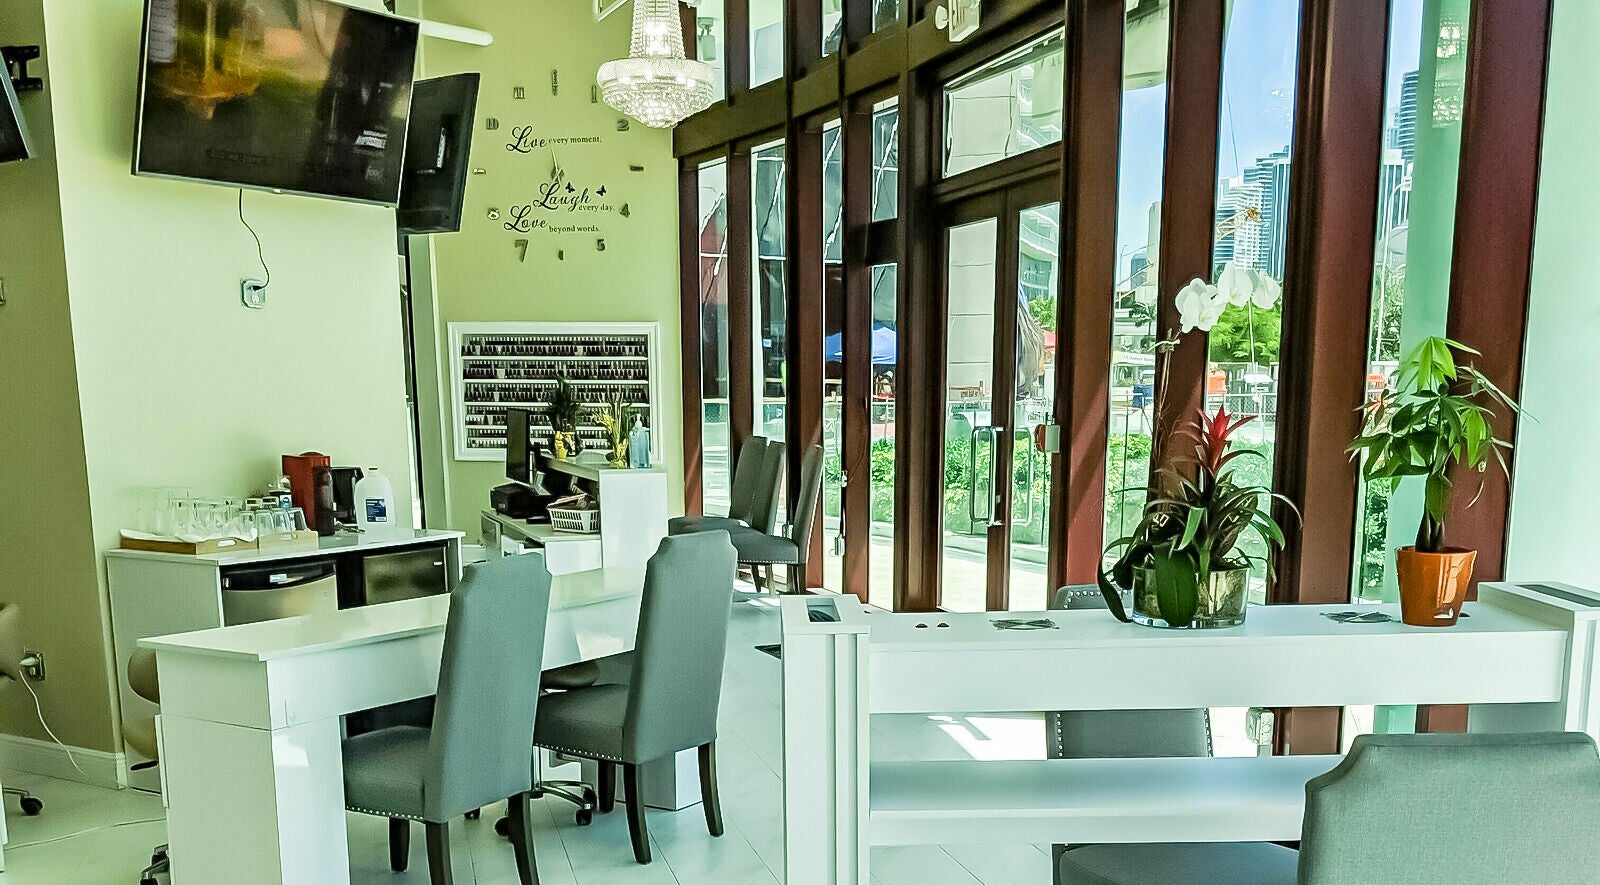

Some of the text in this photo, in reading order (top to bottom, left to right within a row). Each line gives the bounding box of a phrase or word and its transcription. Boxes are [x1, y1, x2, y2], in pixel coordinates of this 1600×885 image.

[506, 126, 547, 153] Live
[533, 182, 590, 212] Laugh
[504, 205, 547, 233] Love
[549, 225, 576, 234] beyond
[515, 239, 528, 262] 7
[597, 239, 605, 251] 5
